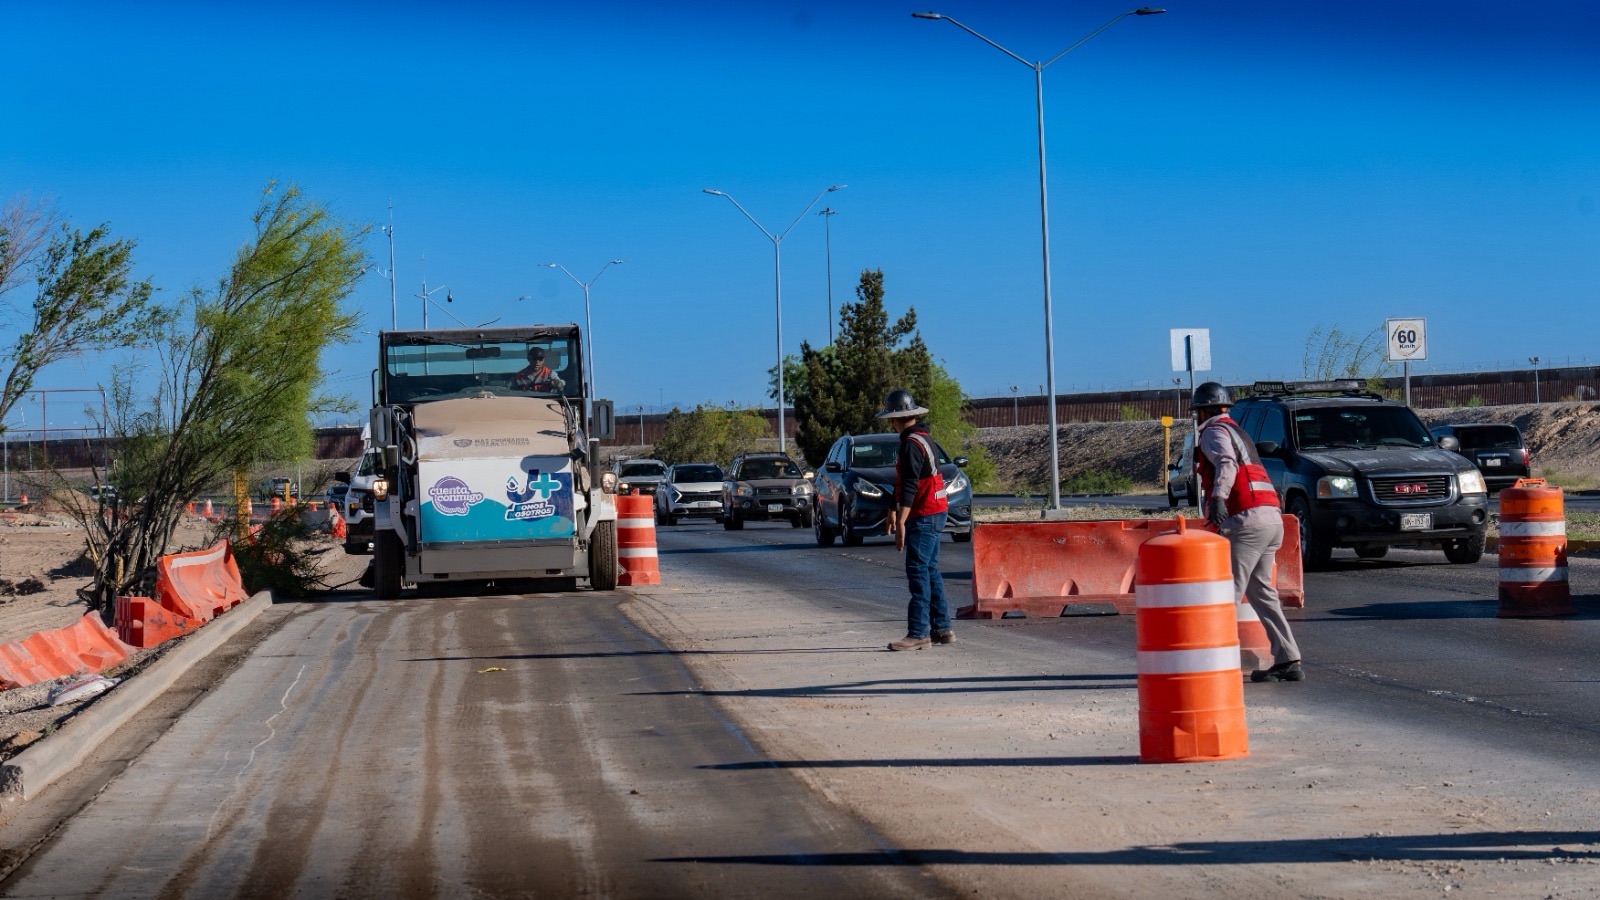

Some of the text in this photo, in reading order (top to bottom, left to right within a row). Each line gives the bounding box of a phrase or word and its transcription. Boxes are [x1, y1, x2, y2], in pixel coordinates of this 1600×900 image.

[1397, 330, 1416, 343] 60
[430, 486, 468, 495] cuenta
[1393, 483, 1429, 494] GMC
[437, 493, 482, 502] conmigo
